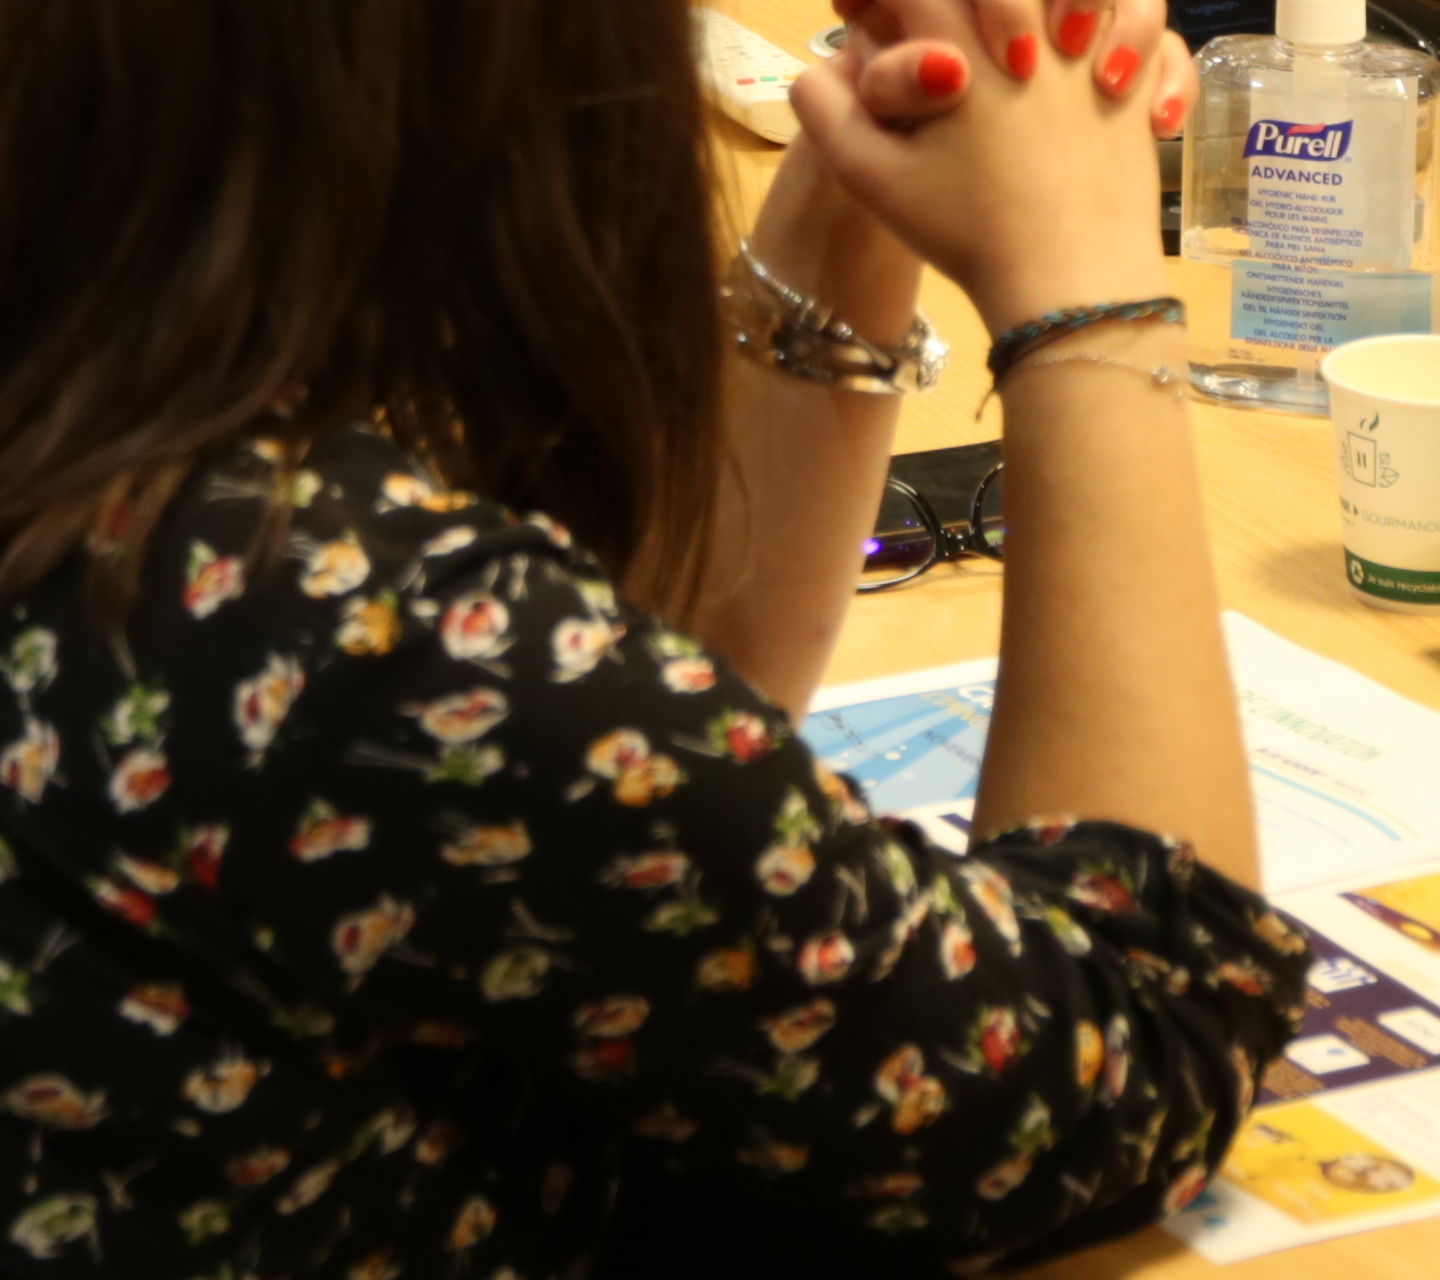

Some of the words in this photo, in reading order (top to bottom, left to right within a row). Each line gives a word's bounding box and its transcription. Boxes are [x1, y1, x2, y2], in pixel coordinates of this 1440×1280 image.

[1256, 122, 1343, 159] Purell
[1251, 165, 1343, 187] ADVANCED
[1257, 188, 1294, 200] HYGIENIC
[1296, 192, 1319, 202] HAND
[1321, 195, 1337, 203] RUB
[1250, 199, 1263, 208] GEL
[1265, 210, 1286, 220] POUR
[1287, 213, 1300, 221] LES
[1302, 214, 1328, 224] MAINS
[1291, 225, 1310, 235] PARA
[1271, 232, 1280, 240] DE
[1282, 233, 1312, 244] MANOS
[1239, 249, 1253, 258] GEL
[1265, 240, 1285, 250] PARA
[1287, 243, 1301, 251] PIEL
[1303, 245, 1326, 254] SANA
[1272, 263, 1293, 272] PARA
[1246, 271, 1305, 285] ONTSMETTENDE
[1307, 277, 1345, 288] HANDGEL
[1267, 285, 1322, 299] HYGIENISCHES
[1243, 303, 1256, 313] GEL
[1263, 317, 1308, 330] HYGIENISKT
[1310, 322, 1325, 332] GEL
[1253, 328, 1267, 337] GEL
[1309, 336, 1322, 344] PER
[1245, 336, 1296, 350] DISINFEZIONE
[1298, 343, 1319, 352] DELLE
[1378, 577, 1395, 589] suis
